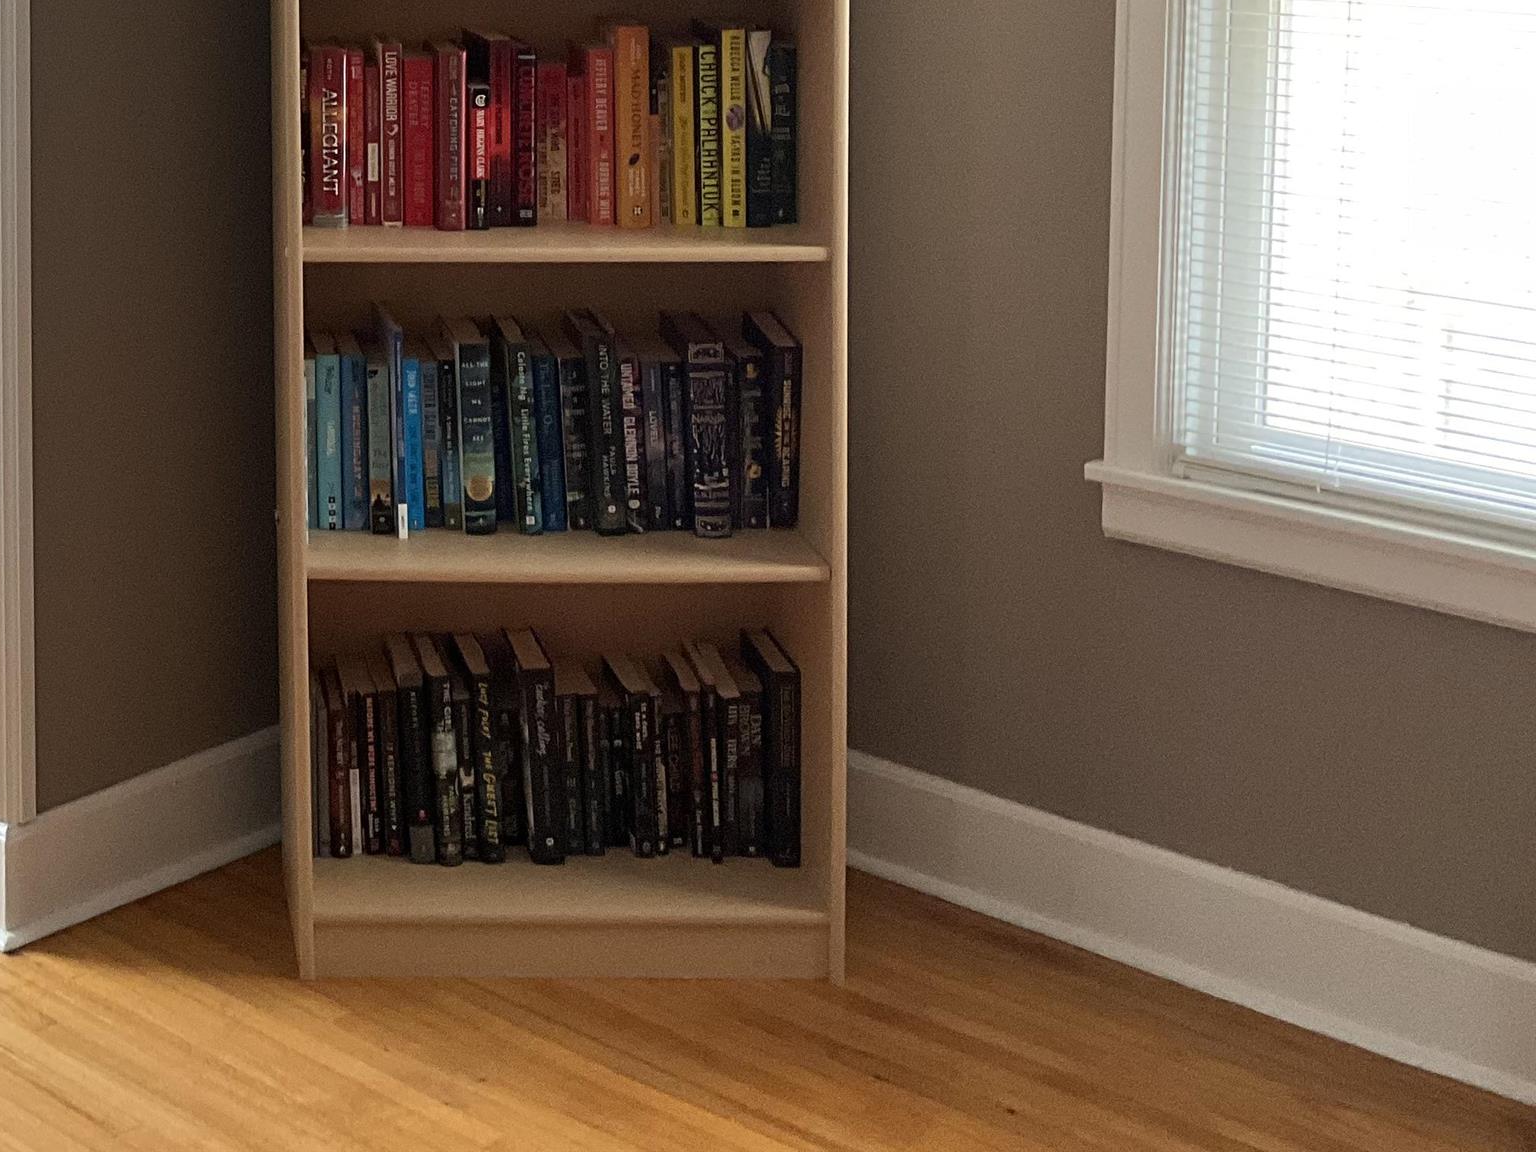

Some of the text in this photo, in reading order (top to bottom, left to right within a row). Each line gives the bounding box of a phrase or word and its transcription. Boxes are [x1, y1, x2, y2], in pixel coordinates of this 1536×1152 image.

[385, 51, 397, 121] LOVE WARRIOR
[730, 35, 740, 100] REBECCA WELLS
[476, 110, 484, 127] MARY
[595, 59, 608, 131] JEFFERY DEAVER
[631, 68, 642, 150] MAD HONEY
[322, 88, 338, 196] ALLEGIANT
[449, 97, 458, 181] CATCHING FIRE
[476, 129, 484, 156] HIGGINS
[551, 134, 560, 151] WHO
[701, 51, 719, 212] CHUCK PALAHNIUK
[599, 161, 609, 197] BURNING
[731, 166, 740, 175] IN
[731, 178, 740, 206] BLOOM
[516, 351, 528, 401] Celeste Ng
[598, 344, 612, 434] INTO THE WATER
[620, 363, 635, 410] UNTAMED
[353, 405, 361, 480] MOCKINGJAY
[520, 409, 534, 511] Little Fires Everywhere
[623, 416, 639, 494] GLENNON DOYLE
[781, 379, 792, 488] SUNRISE REAPING
[602, 455, 610, 498] HAWKINS
[609, 446, 617, 475] PAULA
[479, 683, 491, 738] LUCY FOLEY
[738, 705, 751, 756] BROWN
[751, 715, 761, 745] DAN
[369, 767, 377, 812] INNOCENT
[483, 751, 499, 844] THE GUEST LIST
[464, 793, 475, 841] Kindred
